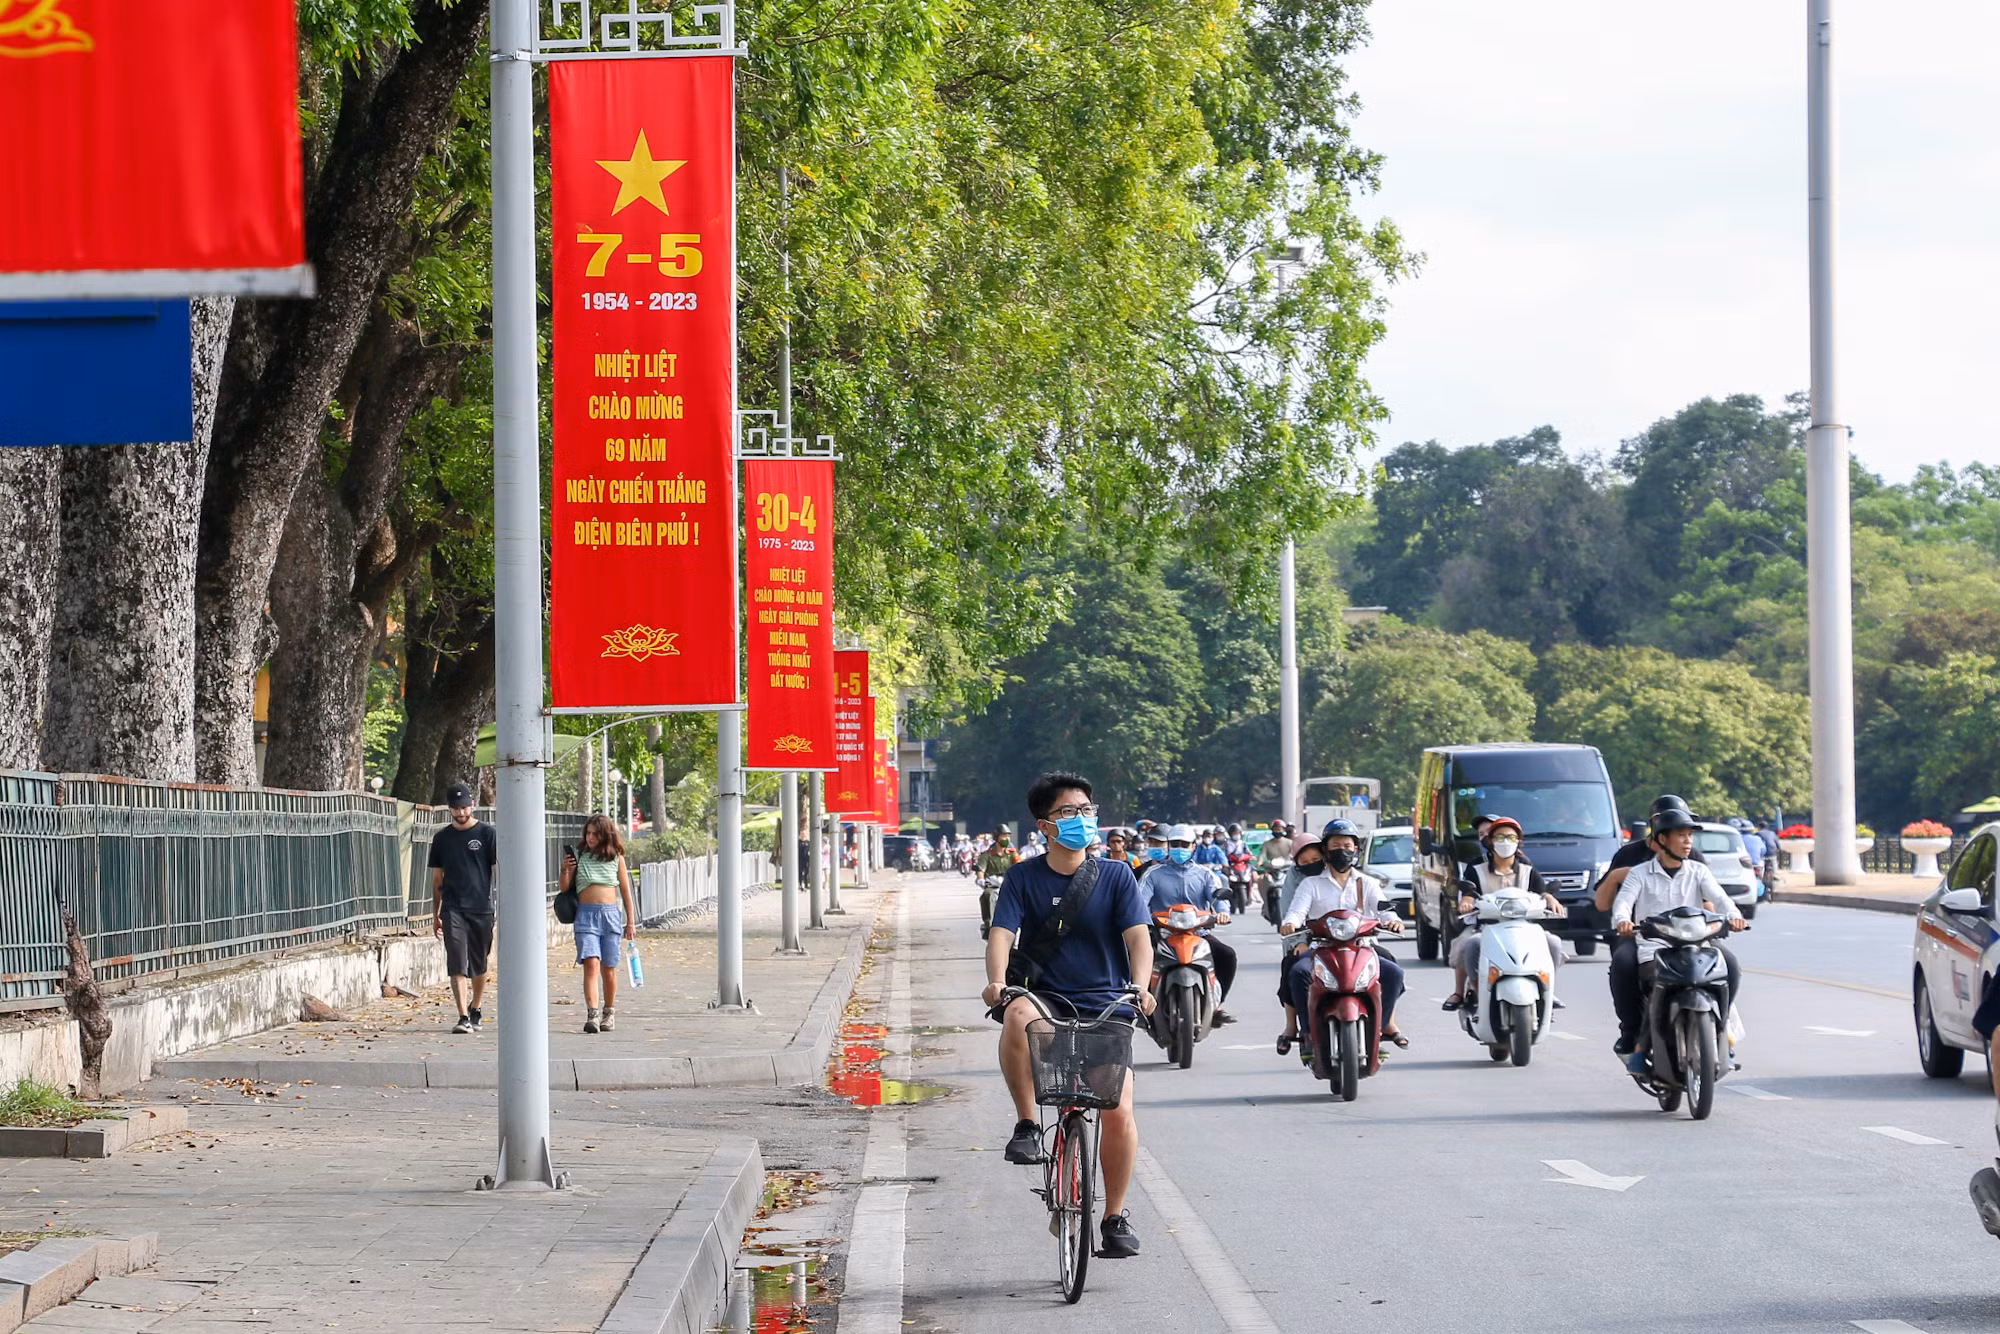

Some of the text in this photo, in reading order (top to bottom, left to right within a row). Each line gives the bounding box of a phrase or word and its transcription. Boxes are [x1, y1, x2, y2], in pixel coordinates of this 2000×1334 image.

[577, 234, 702, 277] 7-5
[582, 293, 629, 310] 1954
[649, 293, 697, 310] 2023
[595, 349, 676, 382] NHIỆT LIỆT
[589, 390, 683, 419] CHÀO MỪNG
[606, 434, 666, 461] 69 NĂM
[567, 472, 705, 503] NGÀY CHIẾN THẮNG
[757, 493, 816, 534] 30-4
[574, 517, 611, 550] ĐIỆN
[616, 518, 651, 545] BIÊN
[657, 512, 688, 545] PHỦ
[759, 538, 781, 548] 1975
[791, 540, 814, 551] 2023
[770, 566, 806, 585] NHIỆT LIỆT
[755, 587, 772, 602] CHÀO
[806, 589, 823, 605] NĂM
[759, 608, 777, 623] NGÀY
[794, 610, 818, 626] PHÓNG
[768, 648, 811, 668] THỐNG NHẤT
